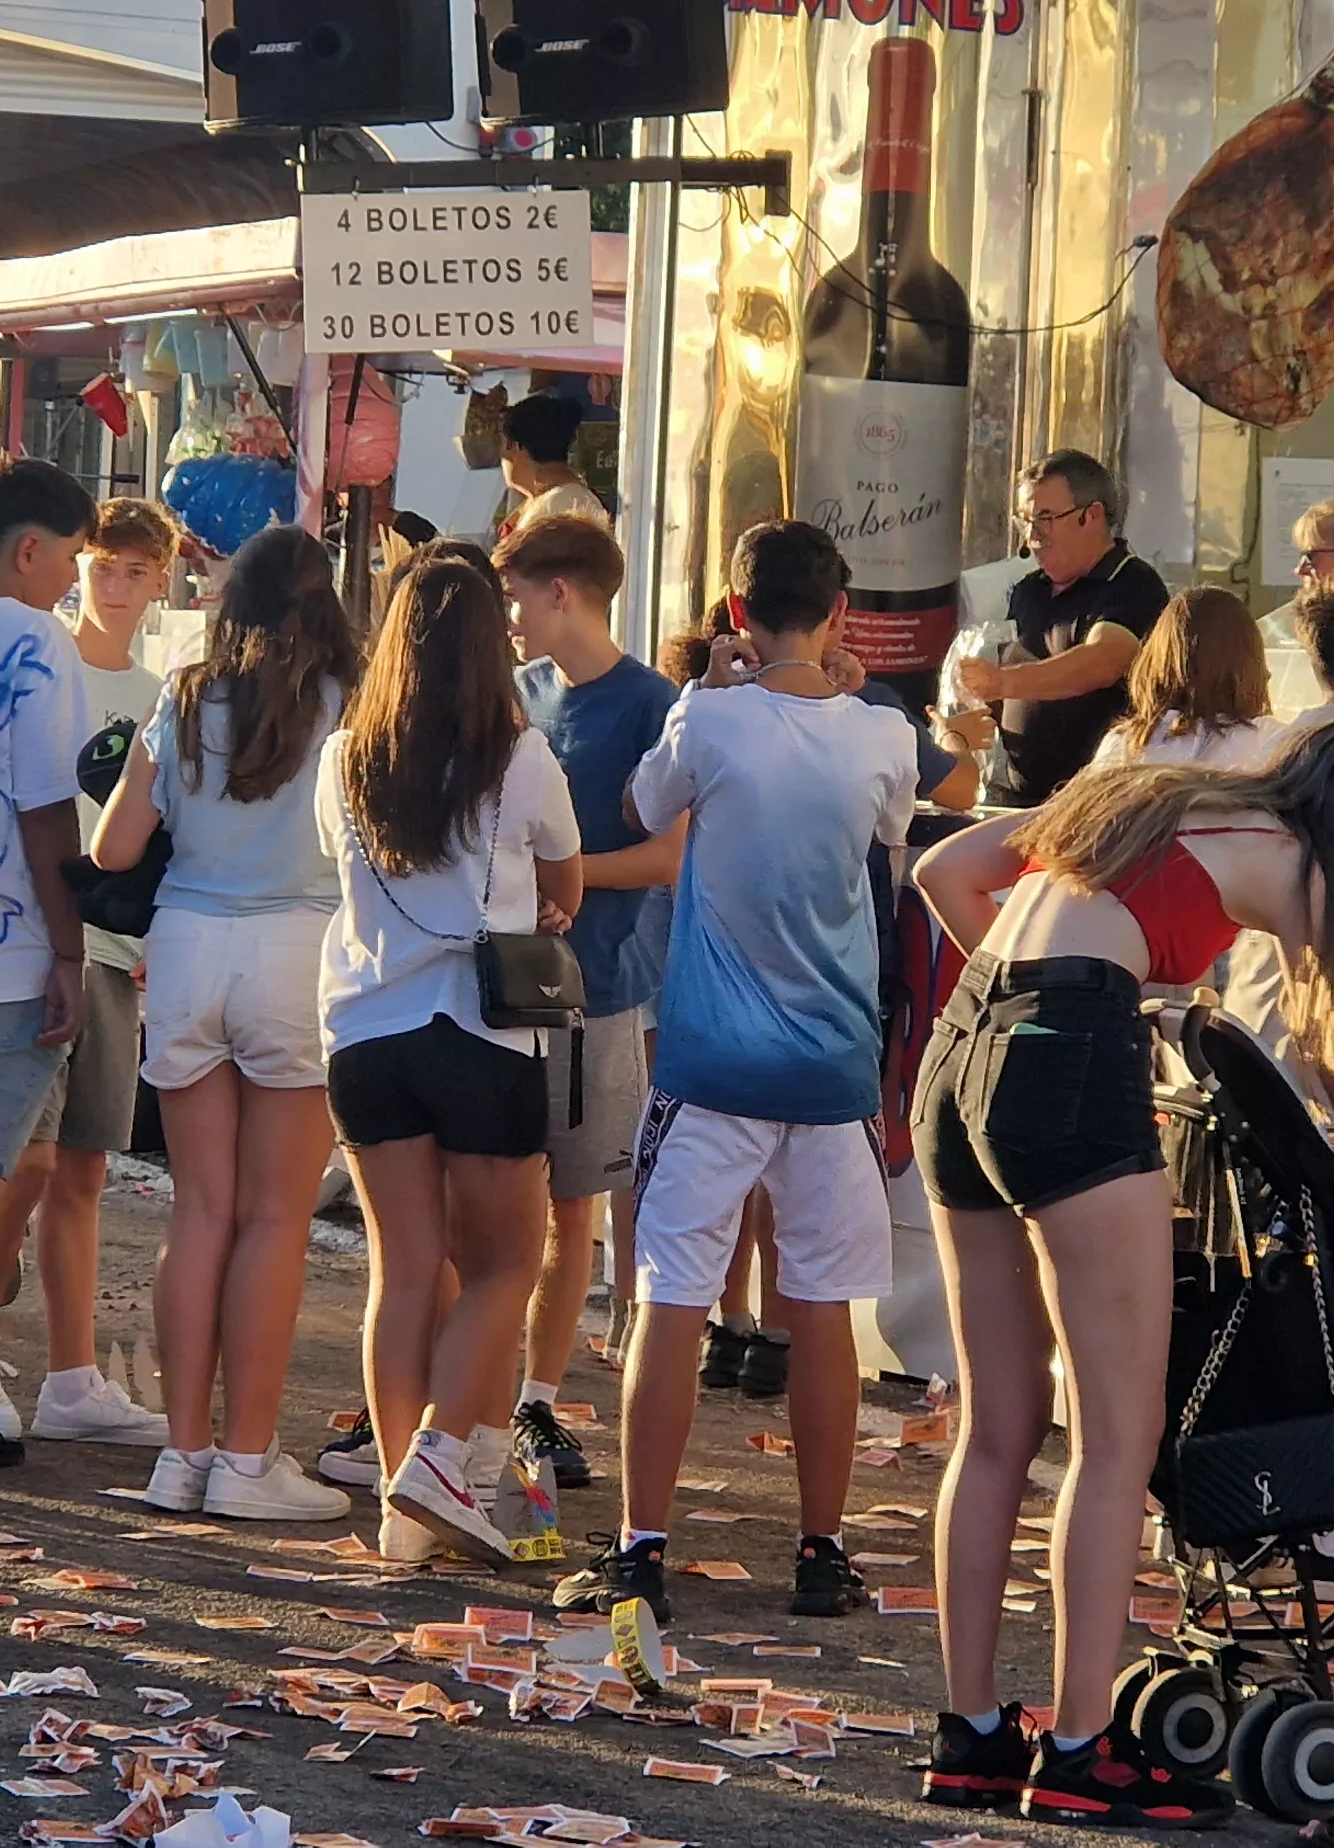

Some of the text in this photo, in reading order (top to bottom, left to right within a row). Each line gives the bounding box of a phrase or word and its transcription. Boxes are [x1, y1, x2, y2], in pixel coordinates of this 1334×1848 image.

[336, 204, 559, 233] 4 BOLETOS 2€
[330, 256, 570, 287] 12 BOLETOS 5€
[322, 309, 580, 340] 30 BOLETOS 10€
[856, 480, 899, 494] PAGO
[810, 491, 943, 543] Balserán
